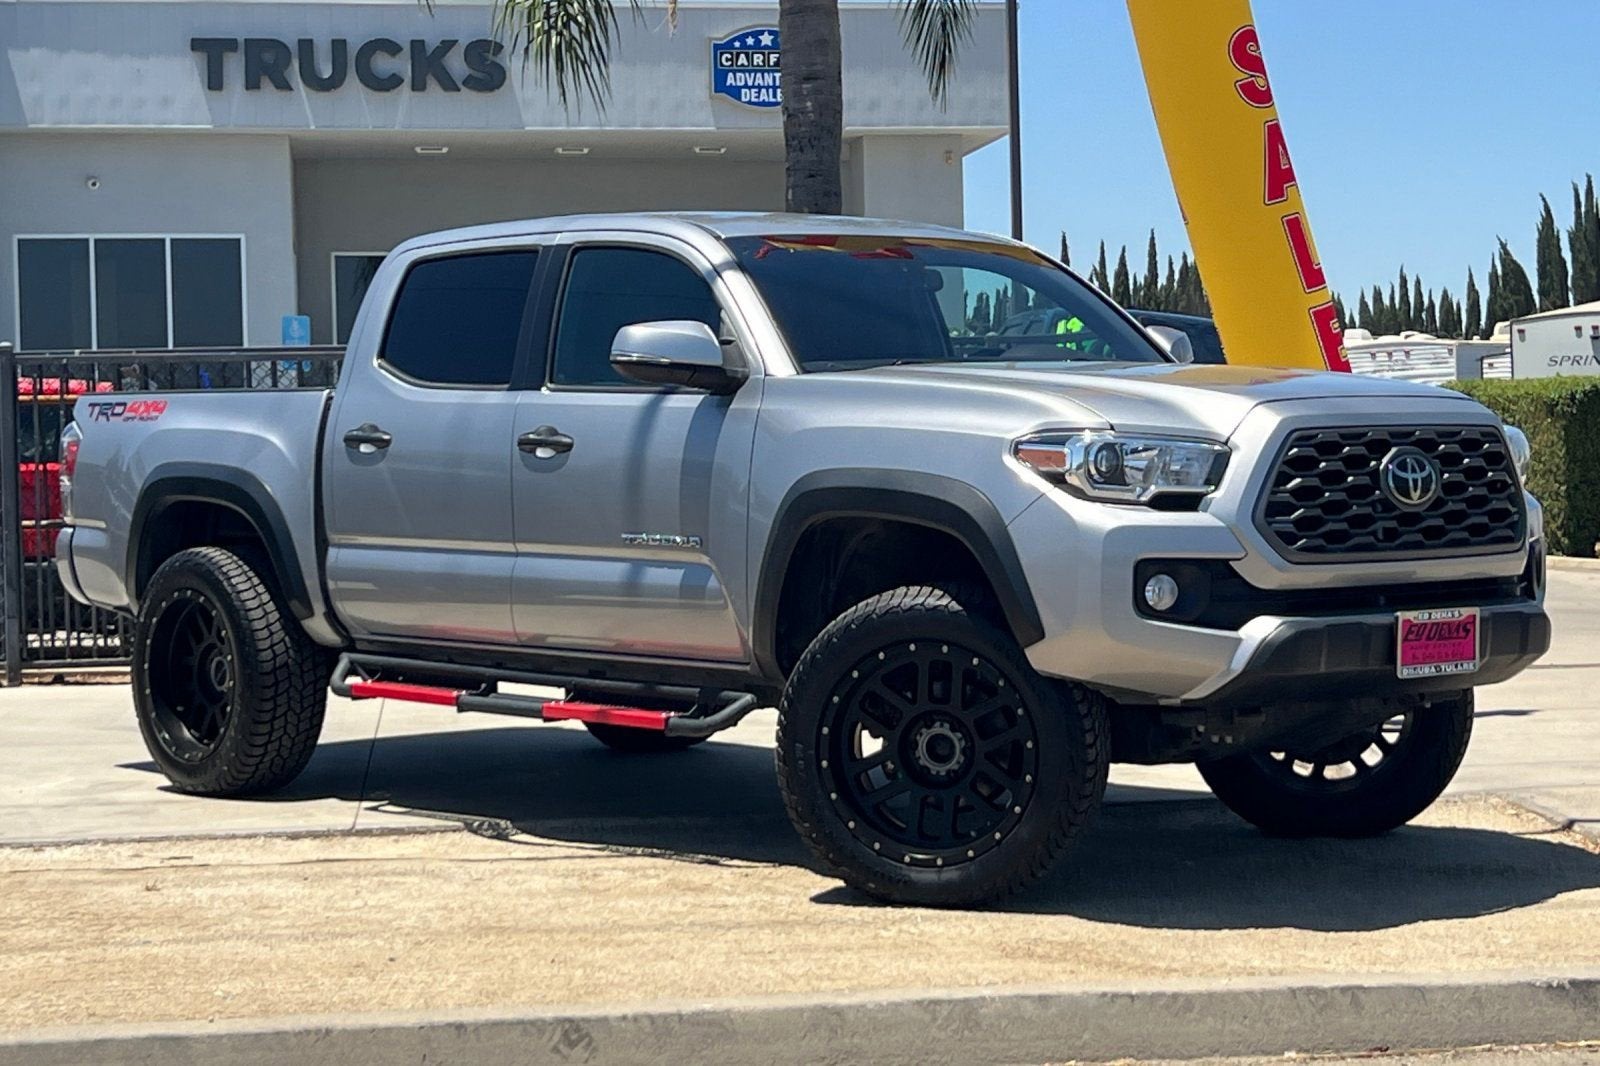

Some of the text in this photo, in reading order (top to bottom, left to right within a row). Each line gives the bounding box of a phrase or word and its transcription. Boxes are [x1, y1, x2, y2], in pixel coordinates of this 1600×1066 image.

[190, 37, 507, 93] TRUCKS
[721, 53, 780, 66] CARF
[726, 72, 782, 87] ADVANT
[741, 88, 784, 102] DEALE
